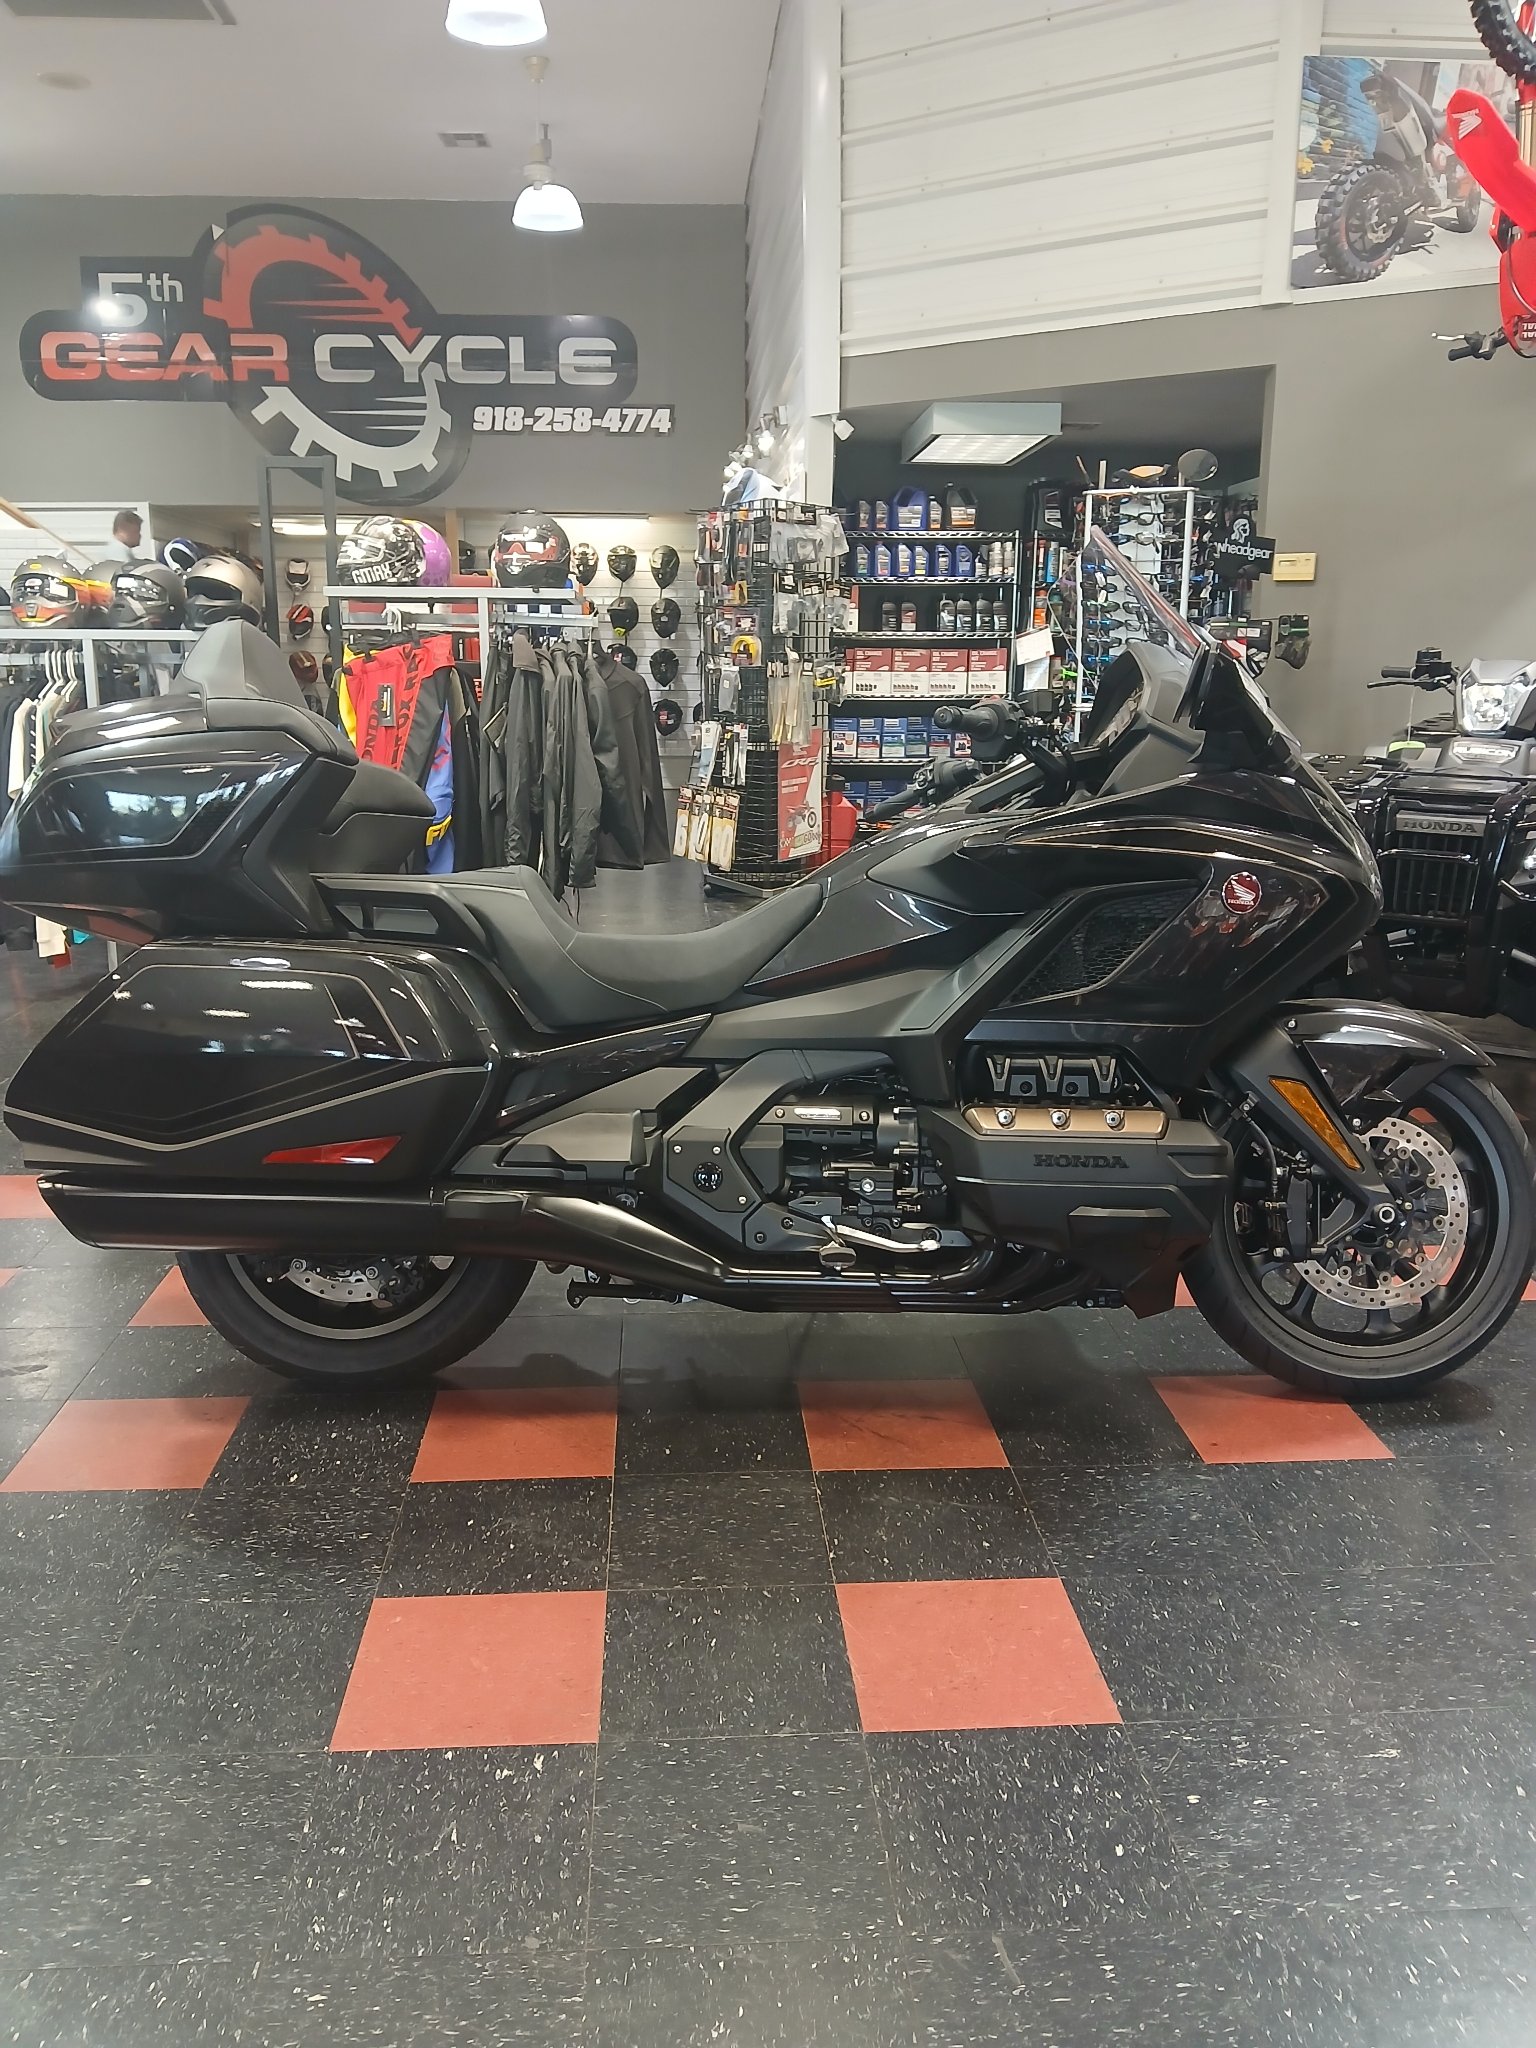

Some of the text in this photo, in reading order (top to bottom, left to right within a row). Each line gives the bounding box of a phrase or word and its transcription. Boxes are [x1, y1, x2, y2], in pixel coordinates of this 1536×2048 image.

[97, 272, 183, 328] 5th
[40, 331, 618, 386] GEAR CYCLE
[473, 406, 671, 433] 918-258-4774
[352, 562, 393, 584] GMAX
[1402, 819, 1478, 834] HONDA
[1227, 898, 1255, 906] HONDA
[1032, 1153, 1130, 1169] HONDA
